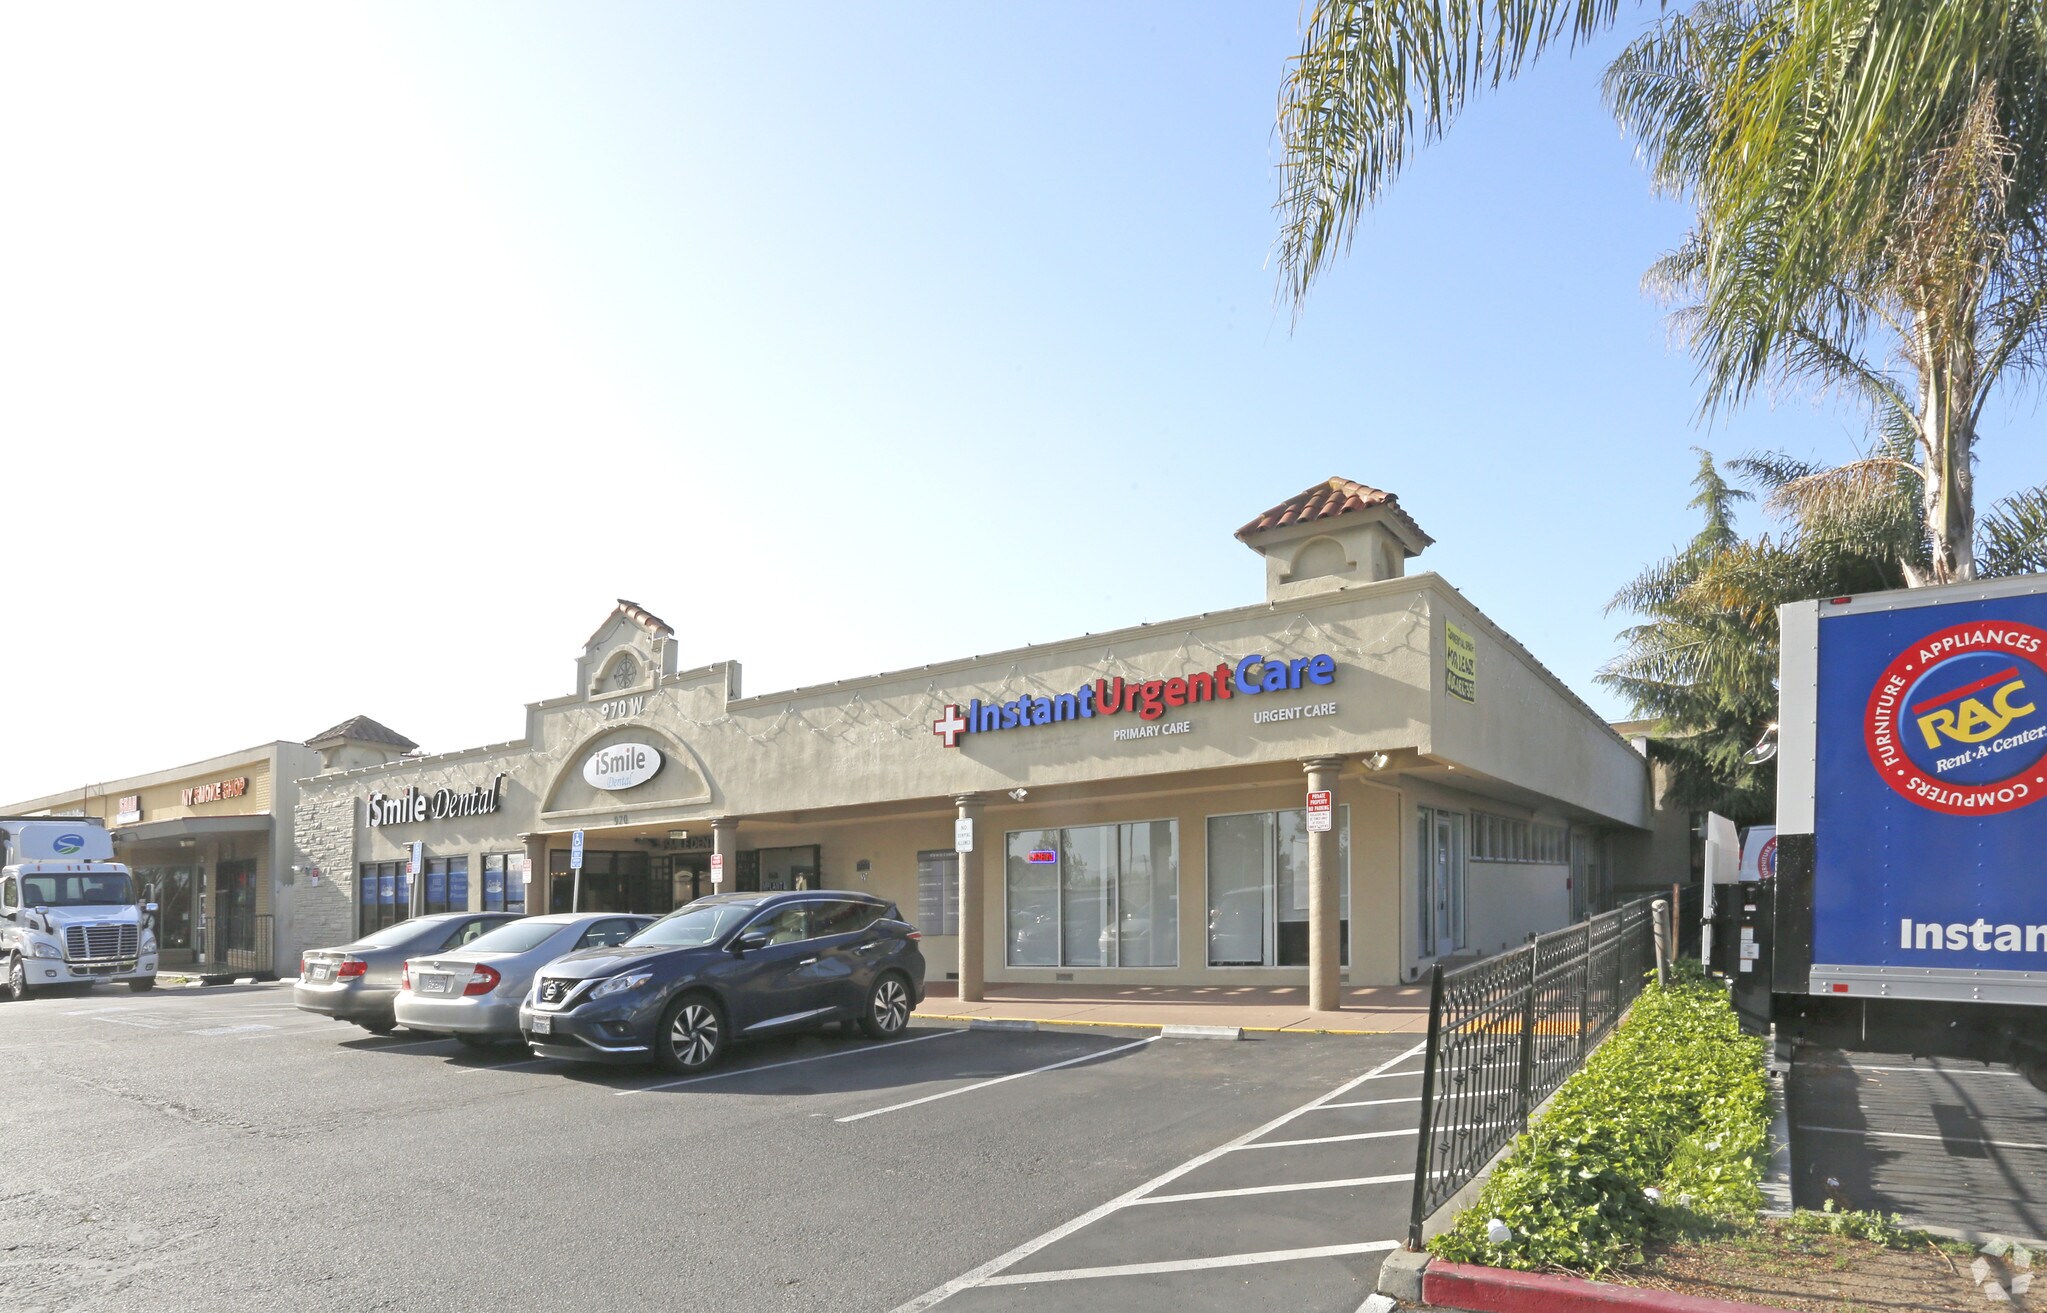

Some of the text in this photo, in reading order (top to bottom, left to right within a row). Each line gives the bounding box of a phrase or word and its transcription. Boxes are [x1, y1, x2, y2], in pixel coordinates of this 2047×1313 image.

[1919, 629, 2041, 664] APPLIANCES
[601, 696, 645, 720] 970 W
[1253, 702, 1337, 725] URGENT CARE
[1874, 674, 1906, 766] FURNITURE
[1917, 679, 2036, 750] RAC
[1113, 721, 1191, 741] PRIMARY CARE
[596, 747, 646, 775] iSmile
[181, 776, 246, 806] MY SMOKE SHOP
[607, 772, 634, 788] Dental
[1906, 777, 2029, 807] COMPUTERS
[366, 772, 504, 828] iSmile Dental
[614, 815, 628, 825] 970
